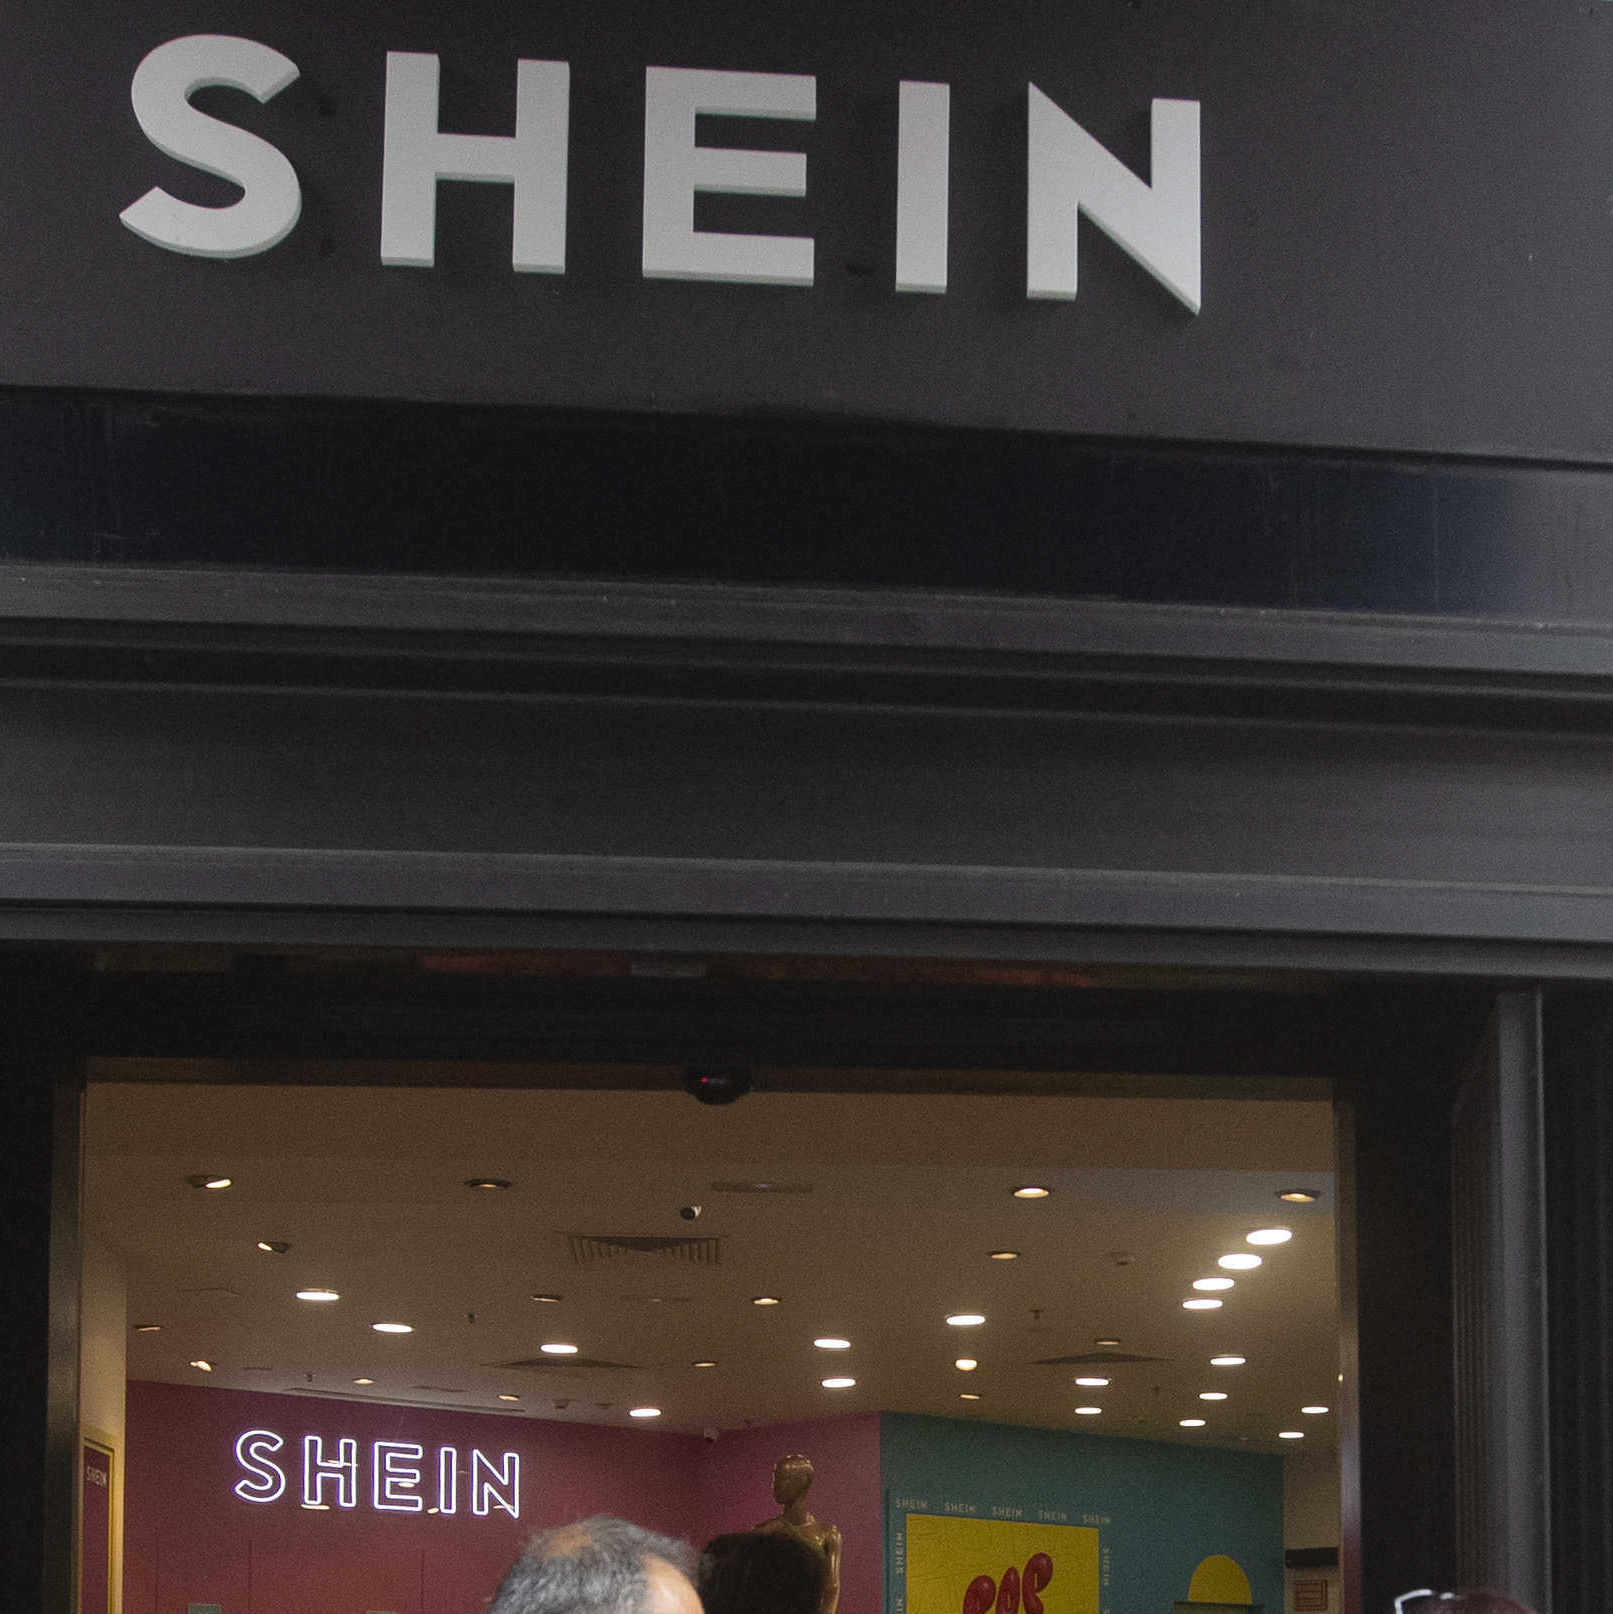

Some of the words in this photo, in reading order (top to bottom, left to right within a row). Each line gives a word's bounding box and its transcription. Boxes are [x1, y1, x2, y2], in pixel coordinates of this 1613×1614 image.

[119, 33, 1202, 315] SHEIN
[86, 1465, 107, 1487] SHEIN
[234, 1429, 520, 1519] SHEIN
[895, 1498, 928, 1511] SHEIN
[944, 1501, 976, 1514] SHEIN
[991, 1506, 1023, 1519] SHEIN
[1037, 1509, 1068, 1522] SHEIN
[1082, 1513, 1111, 1526] SHEIN
[895, 1531, 904, 1575] SHEIN
